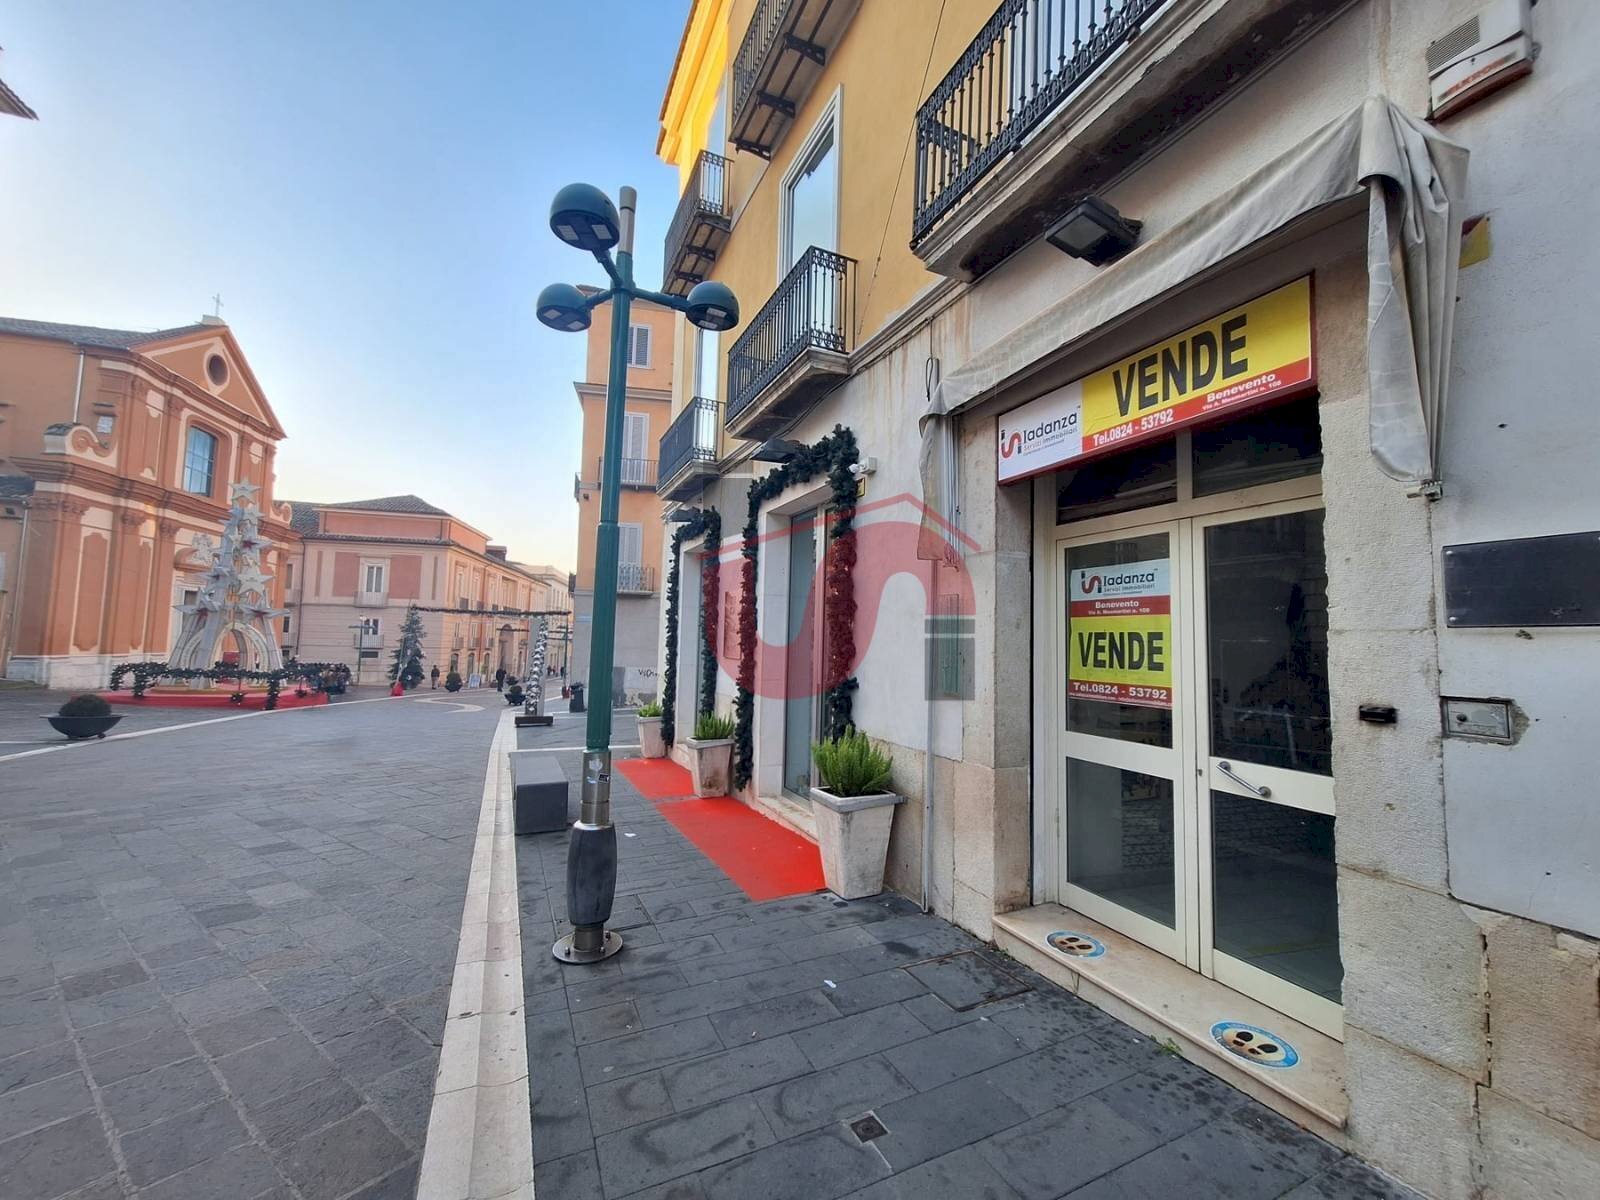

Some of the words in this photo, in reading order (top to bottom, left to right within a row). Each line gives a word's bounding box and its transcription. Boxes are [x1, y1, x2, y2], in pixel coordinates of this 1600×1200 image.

[1111, 313, 1248, 417] VENDE
[1207, 373, 1276, 403] Benevento
[1093, 421, 1133, 447] Tel.0824
[1141, 408, 1174, 432] 53792
[1095, 600, 1140, 609] Benevento
[1078, 631, 1164, 672] VENDE
[1073, 682, 1119, 695] Tel.0824
[1129, 686, 1168, 700] 53792
